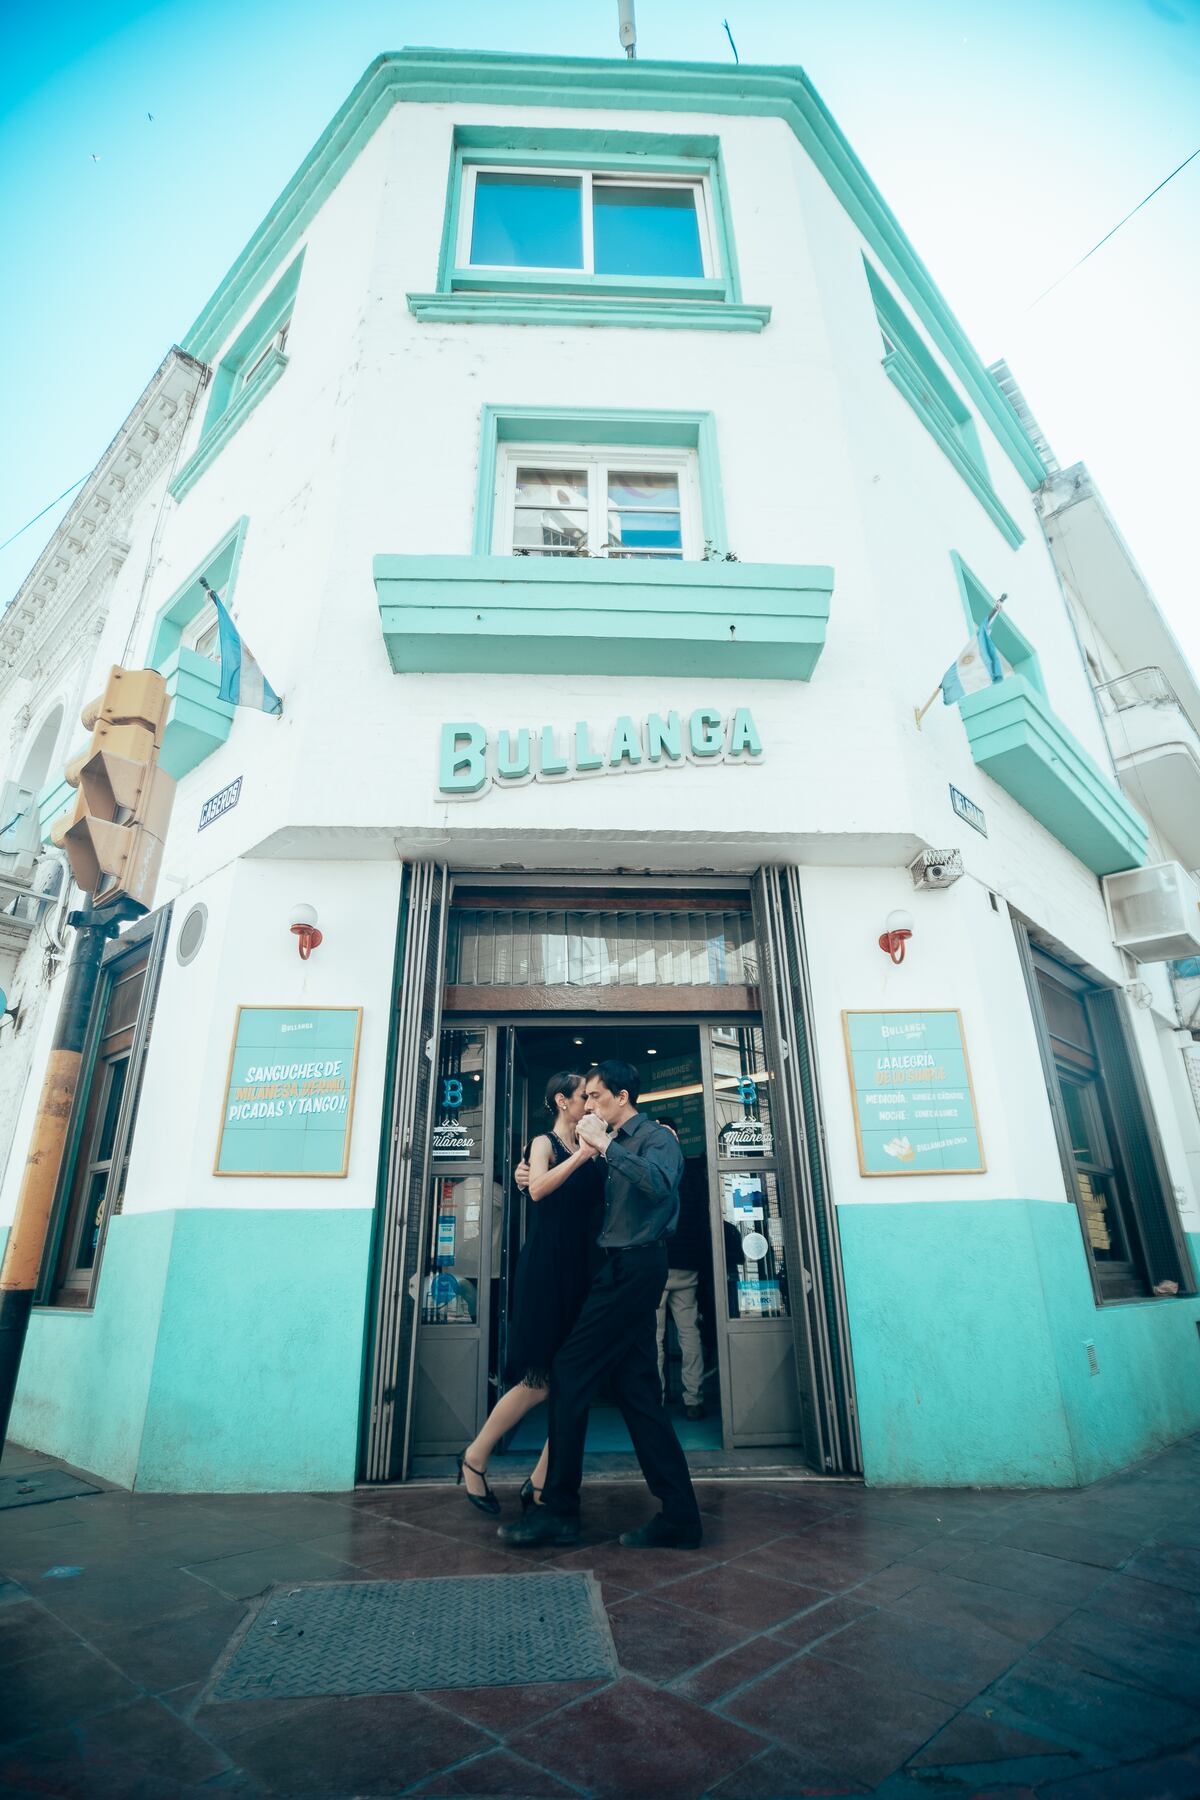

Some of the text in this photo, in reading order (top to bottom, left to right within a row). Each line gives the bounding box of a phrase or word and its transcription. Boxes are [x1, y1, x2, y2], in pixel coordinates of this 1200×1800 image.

[439, 708, 763, 793] BULLANGA
[199, 780, 240, 828] CASEROS
[245, 1060, 343, 1083] SANGUCHES DE
[877, 1051, 936, 1070] LA ALEGRÍA
[443, 1079, 463, 1107] B
[736, 1075, 757, 1104] B
[228, 1095, 348, 1122] PICADAS Y TANGO!!
[723, 1130, 775, 1146] Milanesa
